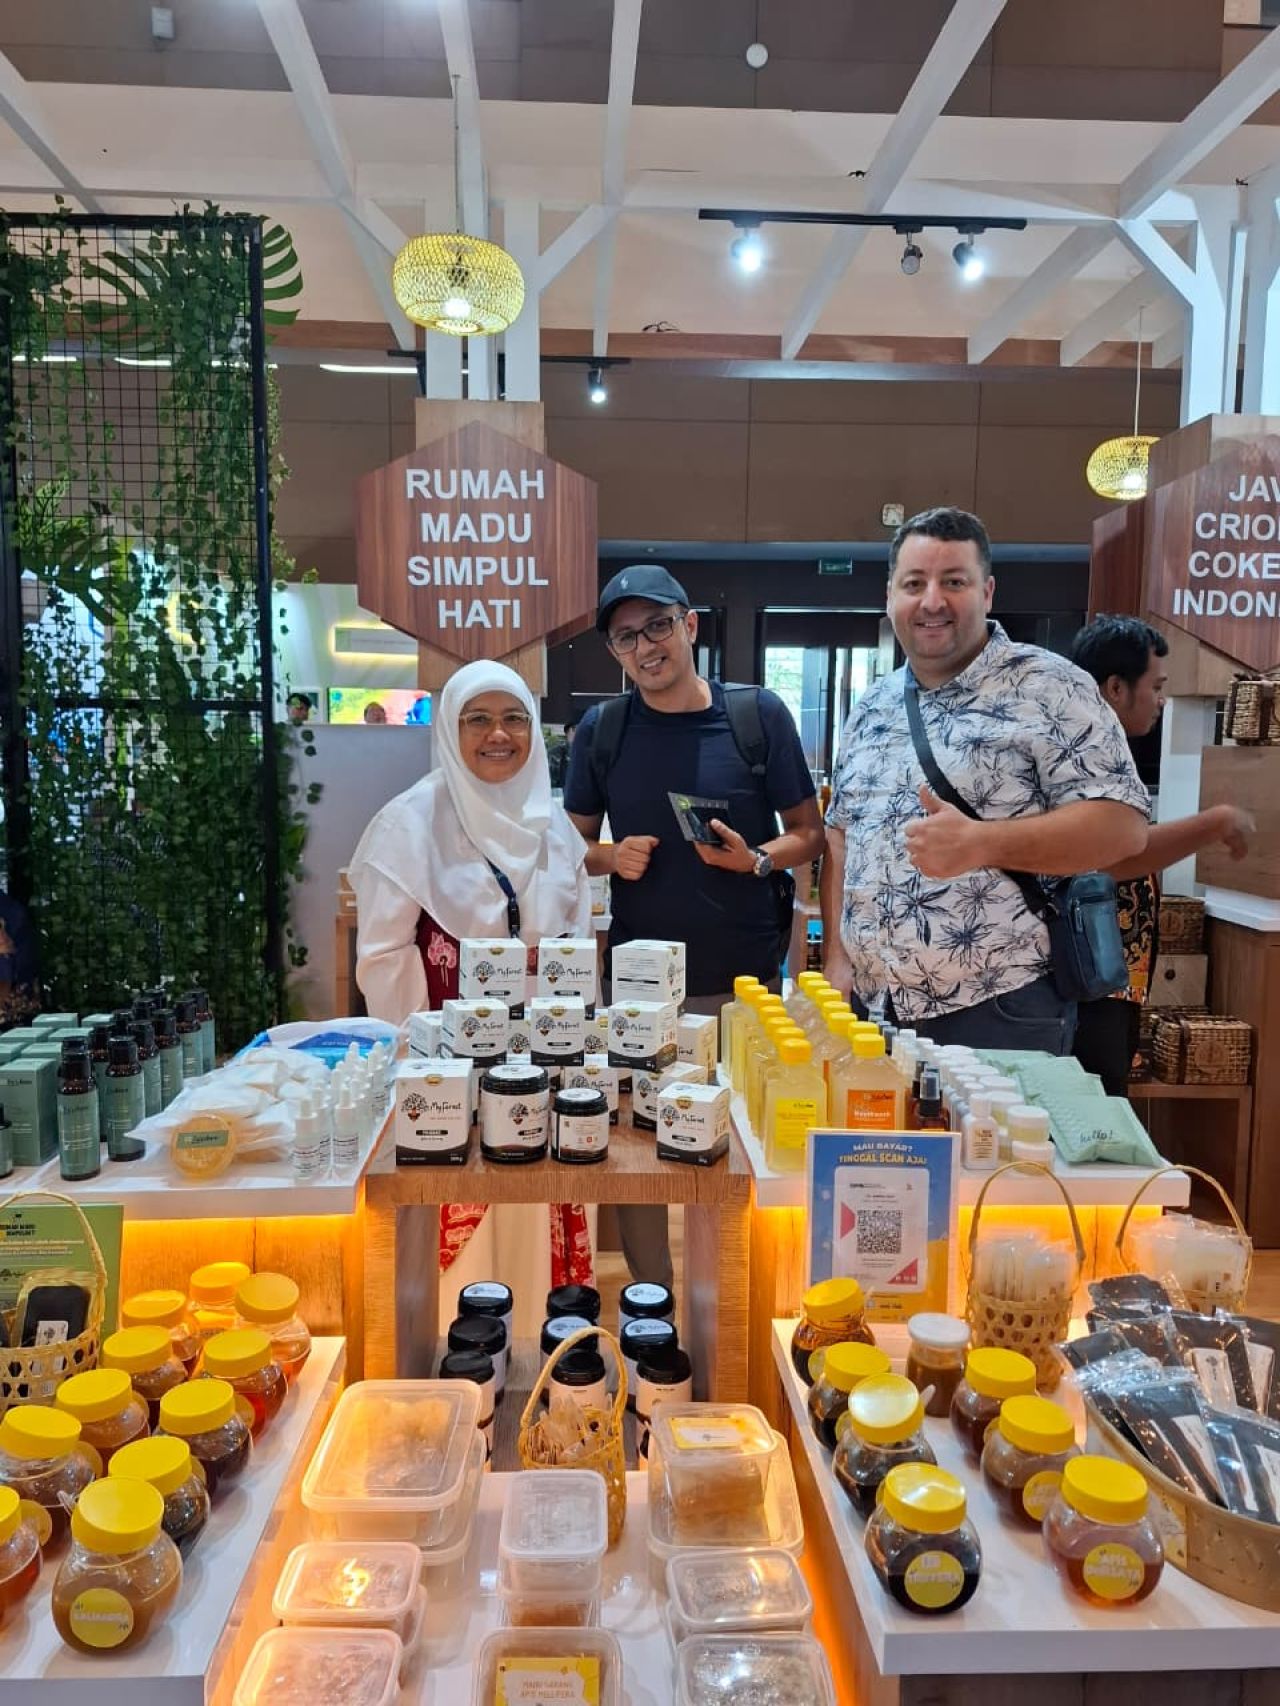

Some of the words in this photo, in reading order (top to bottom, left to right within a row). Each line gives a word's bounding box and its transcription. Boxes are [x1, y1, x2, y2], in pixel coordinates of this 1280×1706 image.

[406, 469, 545, 499] RUMAH
[421, 513, 532, 543] MADU
[1195, 512, 1280, 541] CRIO
[407, 556, 549, 586] SIMPUL
[438, 599, 521, 629] HATI
[1172, 588, 1280, 618] INDON
[880, 1154, 905, 1163] SCAN
